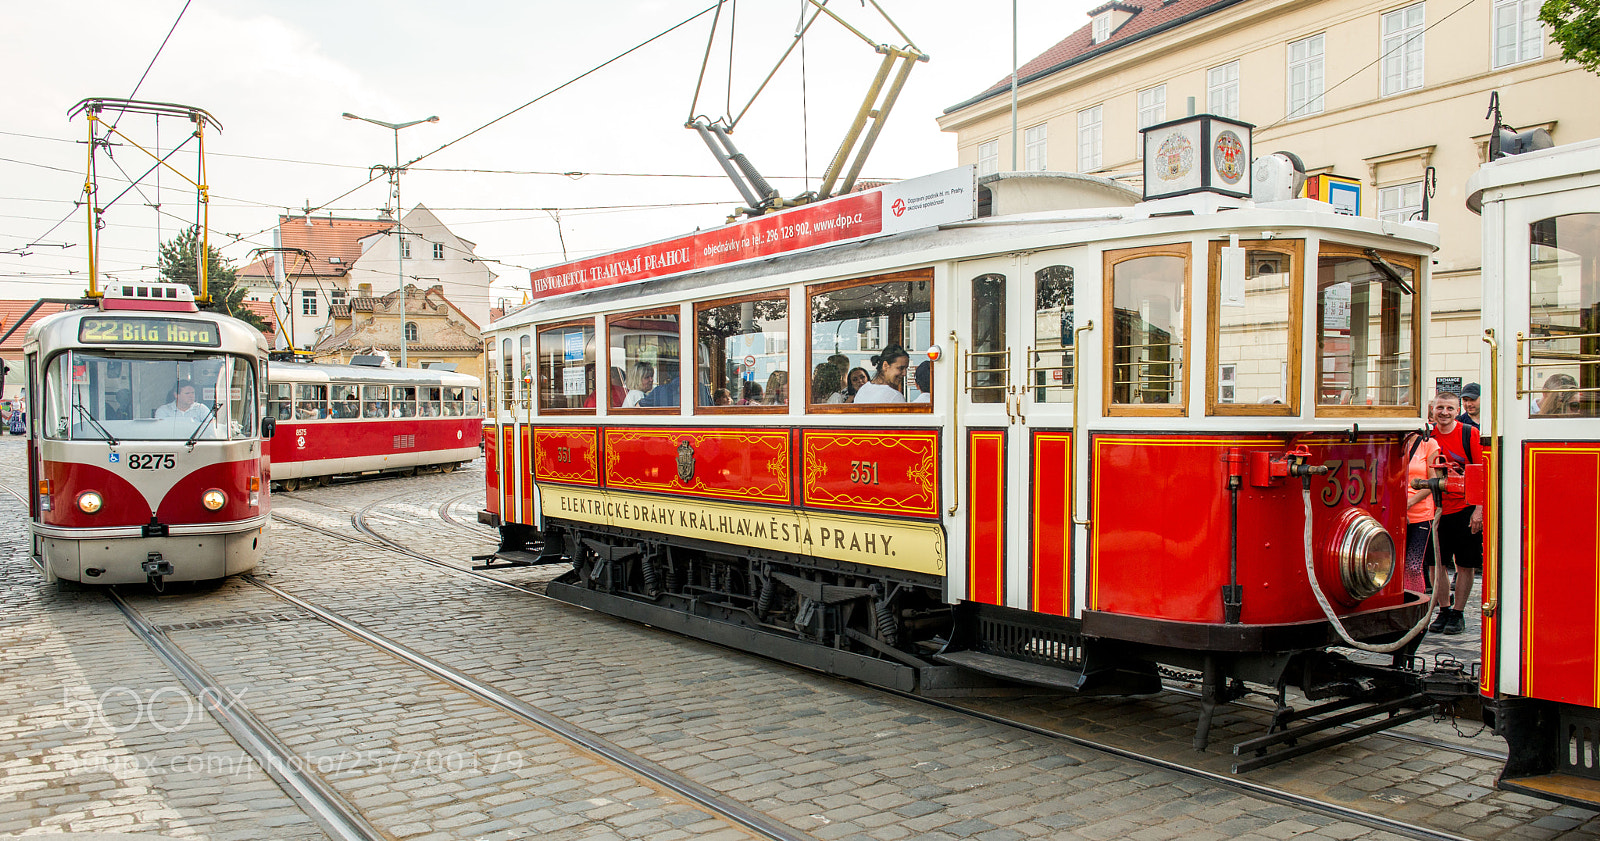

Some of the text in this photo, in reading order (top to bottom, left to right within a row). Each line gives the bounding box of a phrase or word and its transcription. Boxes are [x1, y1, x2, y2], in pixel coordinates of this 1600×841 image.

[703, 238, 740, 256] objednávky
[741, 237, 750, 248] na
[766, 230, 779, 243] 296
[780, 226, 794, 239] 128
[795, 222, 812, 236] 902,
[813, 213, 862, 232] www.dpp.cz
[534, 247, 690, 292] HISTORICKOU TRAMVAJÍ PRAHOU
[85, 320, 118, 340] 22
[167, 324, 209, 342] Hora
[295, 428, 307, 436] 8575
[128, 454, 176, 469] 8275
[557, 446, 571, 463] 351
[850, 460, 879, 485] 351
[1321, 458, 1378, 507] 351
[560, 496, 629, 520] ELEKTRICKÉ
[633, 504, 675, 526] DRÁHY
[820, 527, 896, 557] PRAHY.
